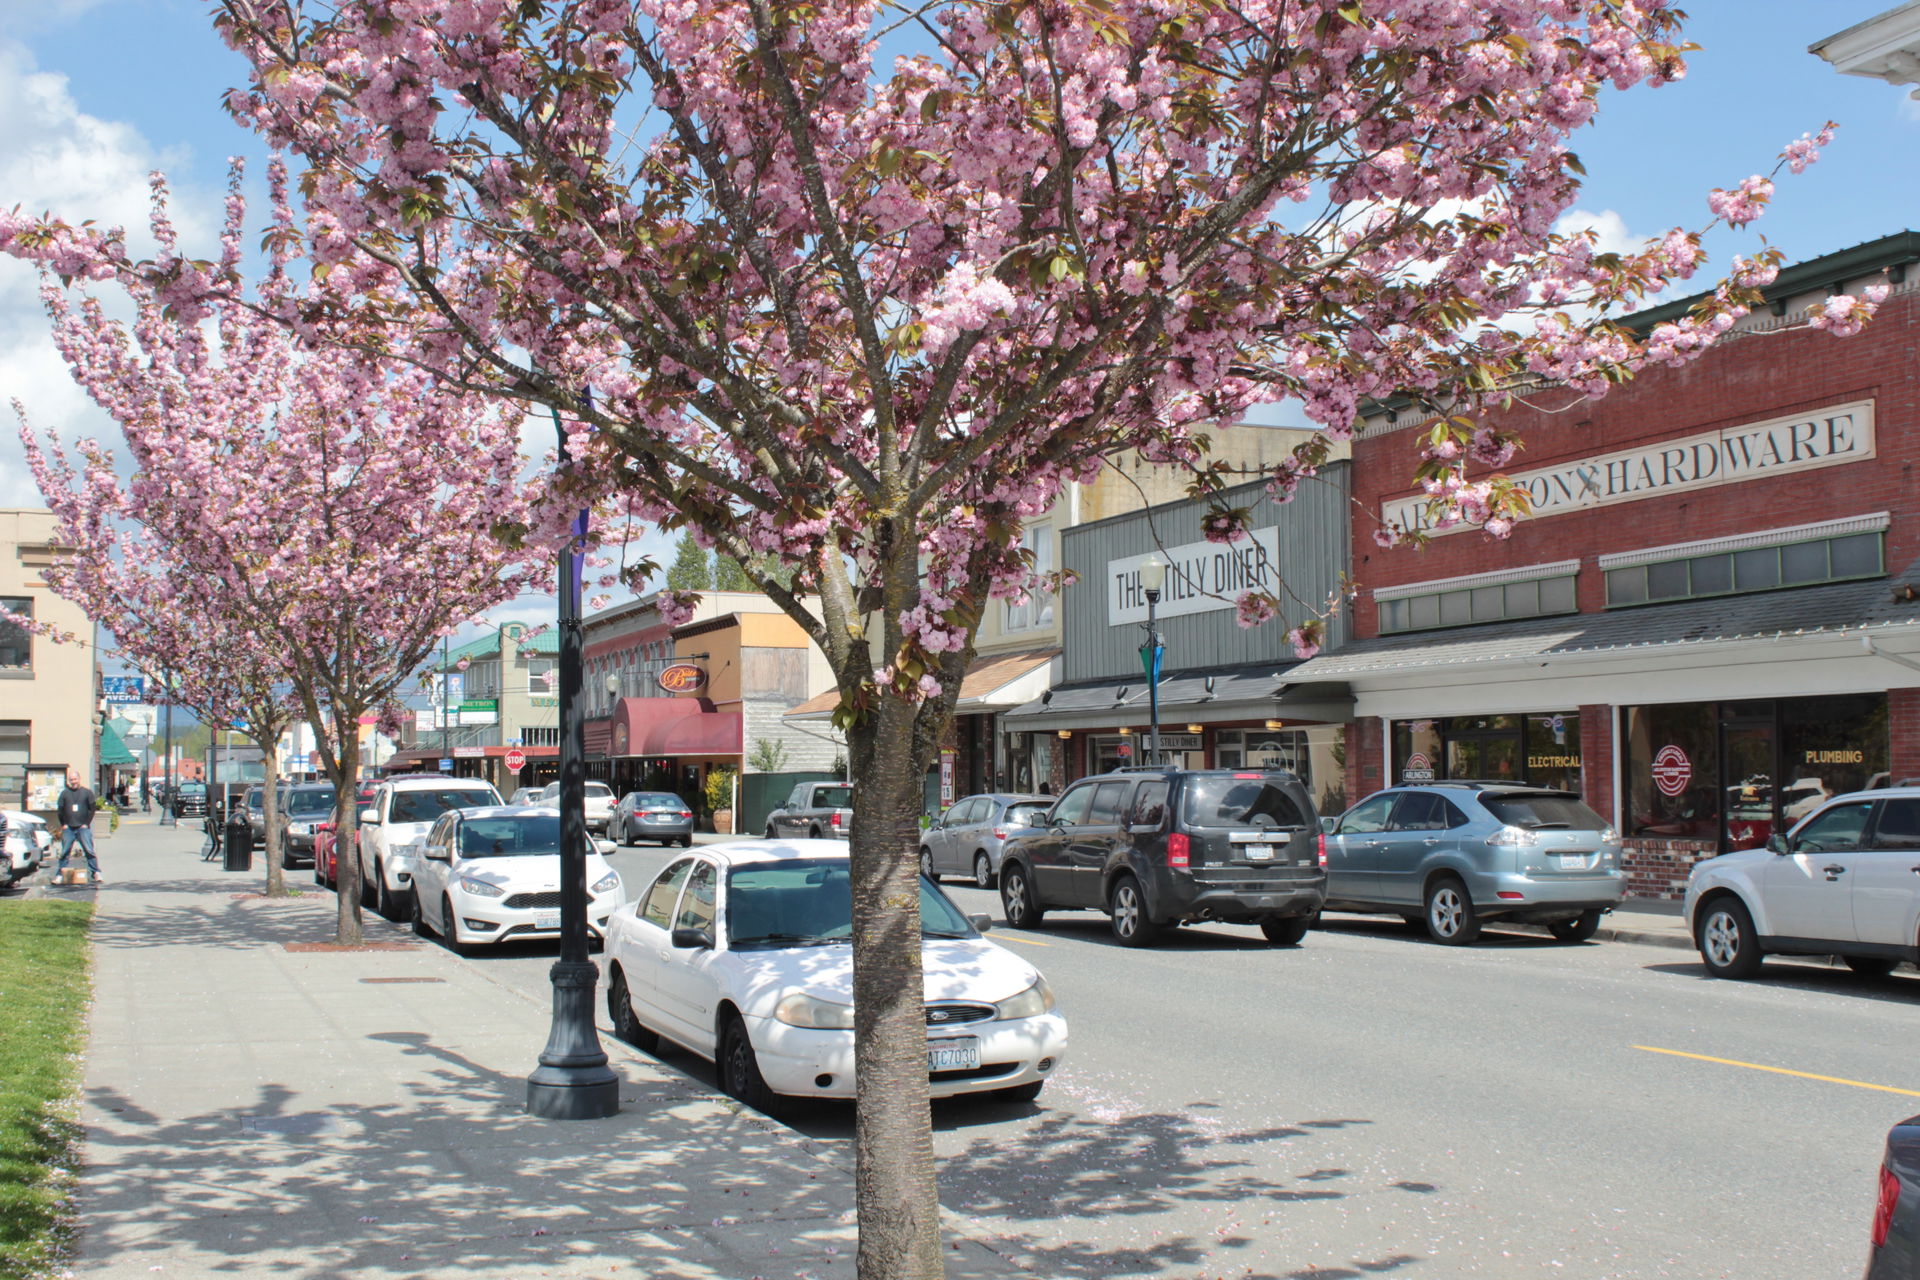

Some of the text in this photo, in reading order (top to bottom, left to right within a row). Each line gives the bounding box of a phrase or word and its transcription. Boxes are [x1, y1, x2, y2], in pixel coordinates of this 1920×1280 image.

[1604, 414, 1854, 496] HARDWARE
[1116, 571, 1145, 610] THE
[1215, 546, 1268, 594] DINER
[506, 756, 524, 764] STOP
[1527, 756, 1581, 768] ELECTRICAL
[1805, 750, 1863, 763] PLUMBING
[927, 1048, 977, 1066] ATC7030
